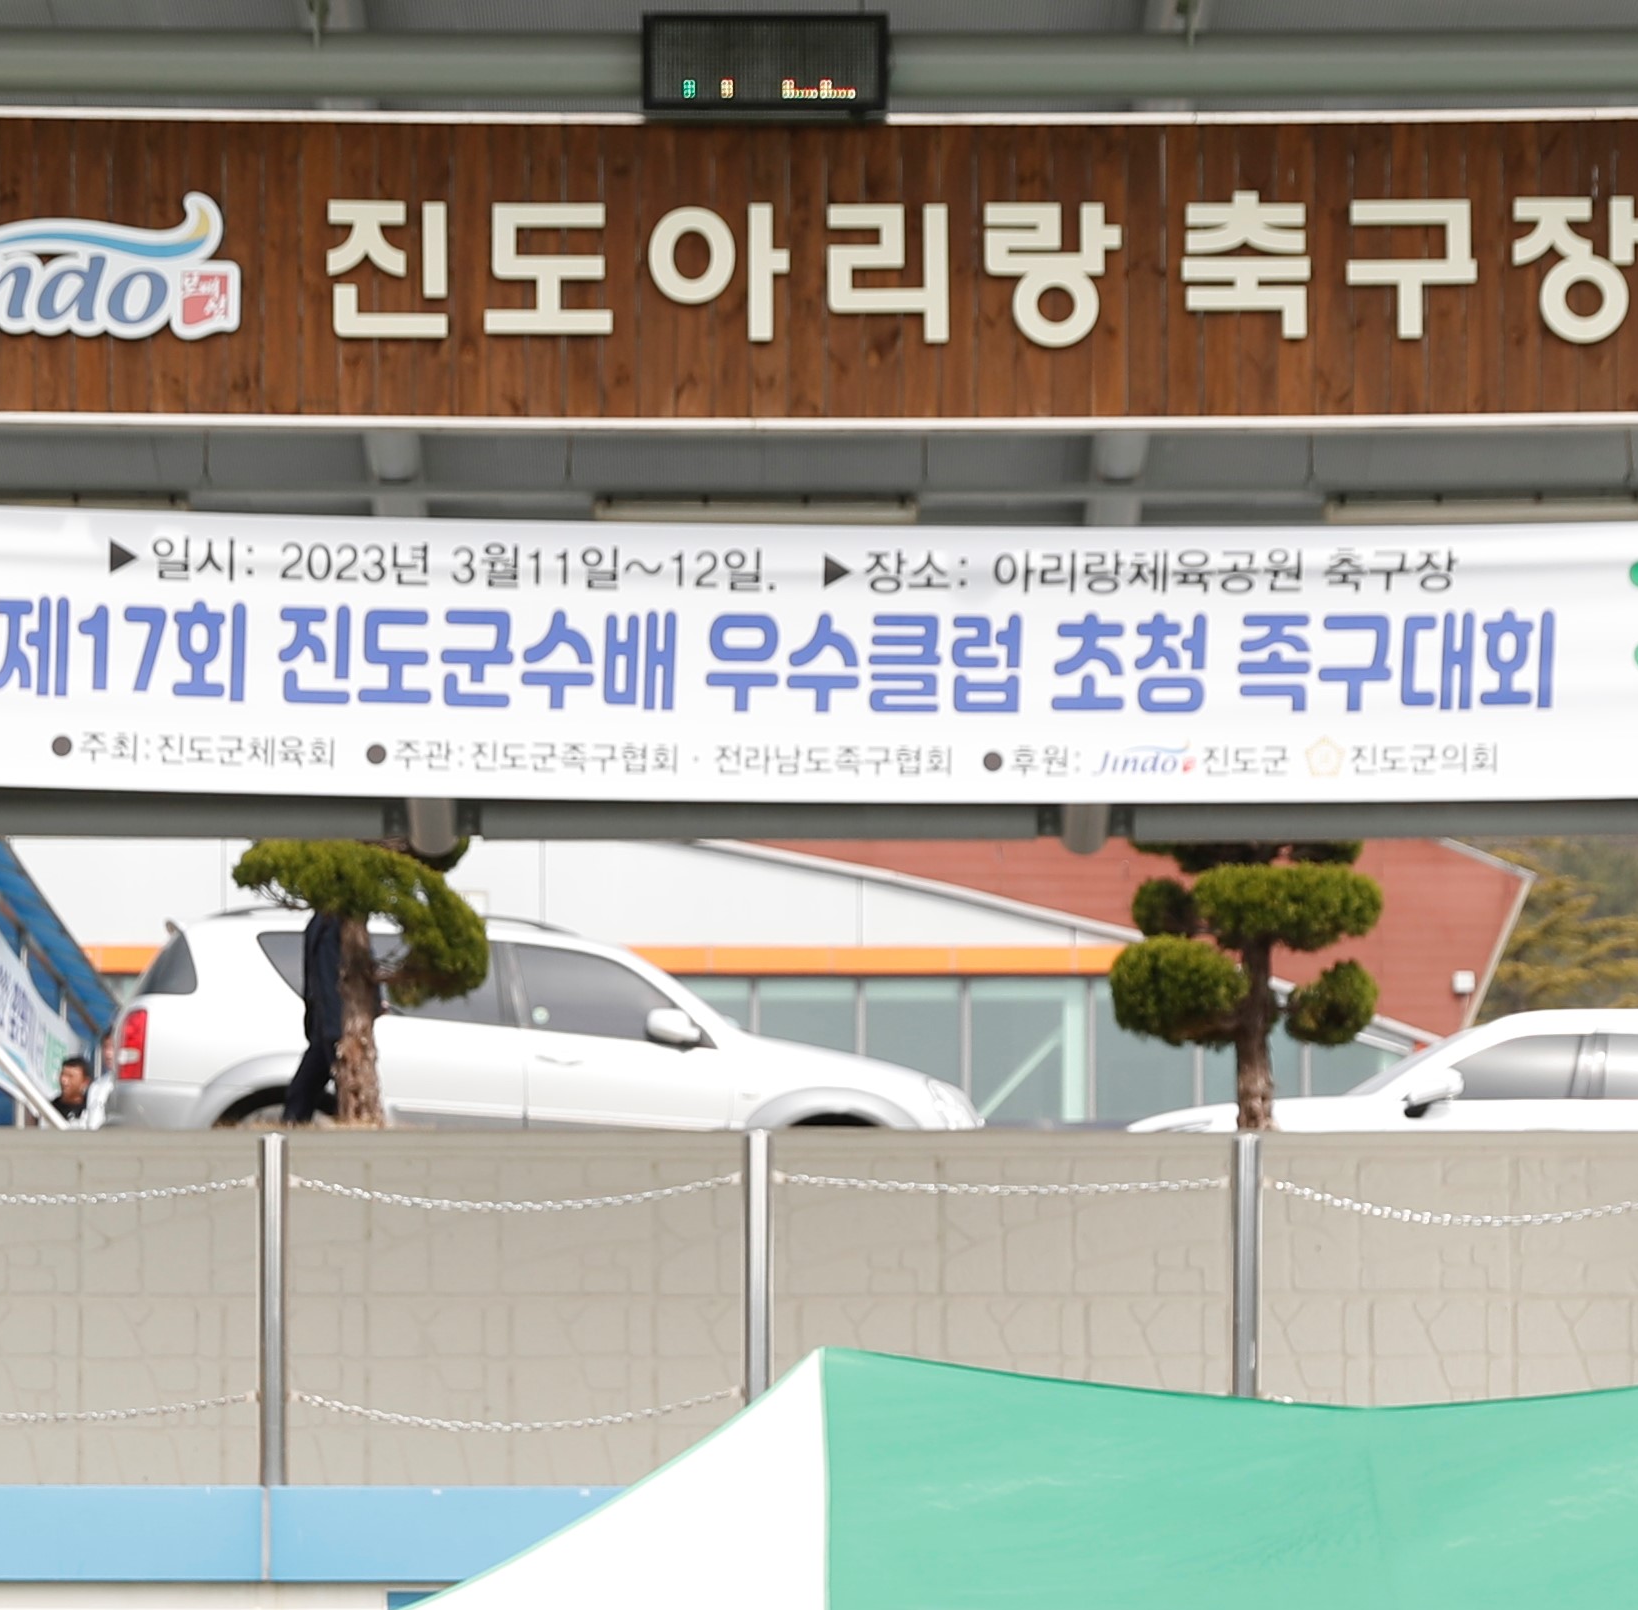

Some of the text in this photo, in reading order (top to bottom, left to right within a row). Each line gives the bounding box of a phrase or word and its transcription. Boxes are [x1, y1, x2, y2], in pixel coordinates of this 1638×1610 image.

[325, 199, 1124, 349] 진도아리랑
[151, 535, 1459, 596] 일시: 2023년 3월11일~12일. 장소: 아리랑체육공원 축구장
[277, 603, 678, 711] 진도군수배
[705, 611, 1023, 714] 우수클럽
[1050, 611, 1208, 714] 초청
[1237, 608, 1556, 713] 족구대회
[1009, 744, 1081, 777] 후원:
[1202, 744, 1289, 777] 진도군
[1350, 742, 1499, 776] 진도군의회
